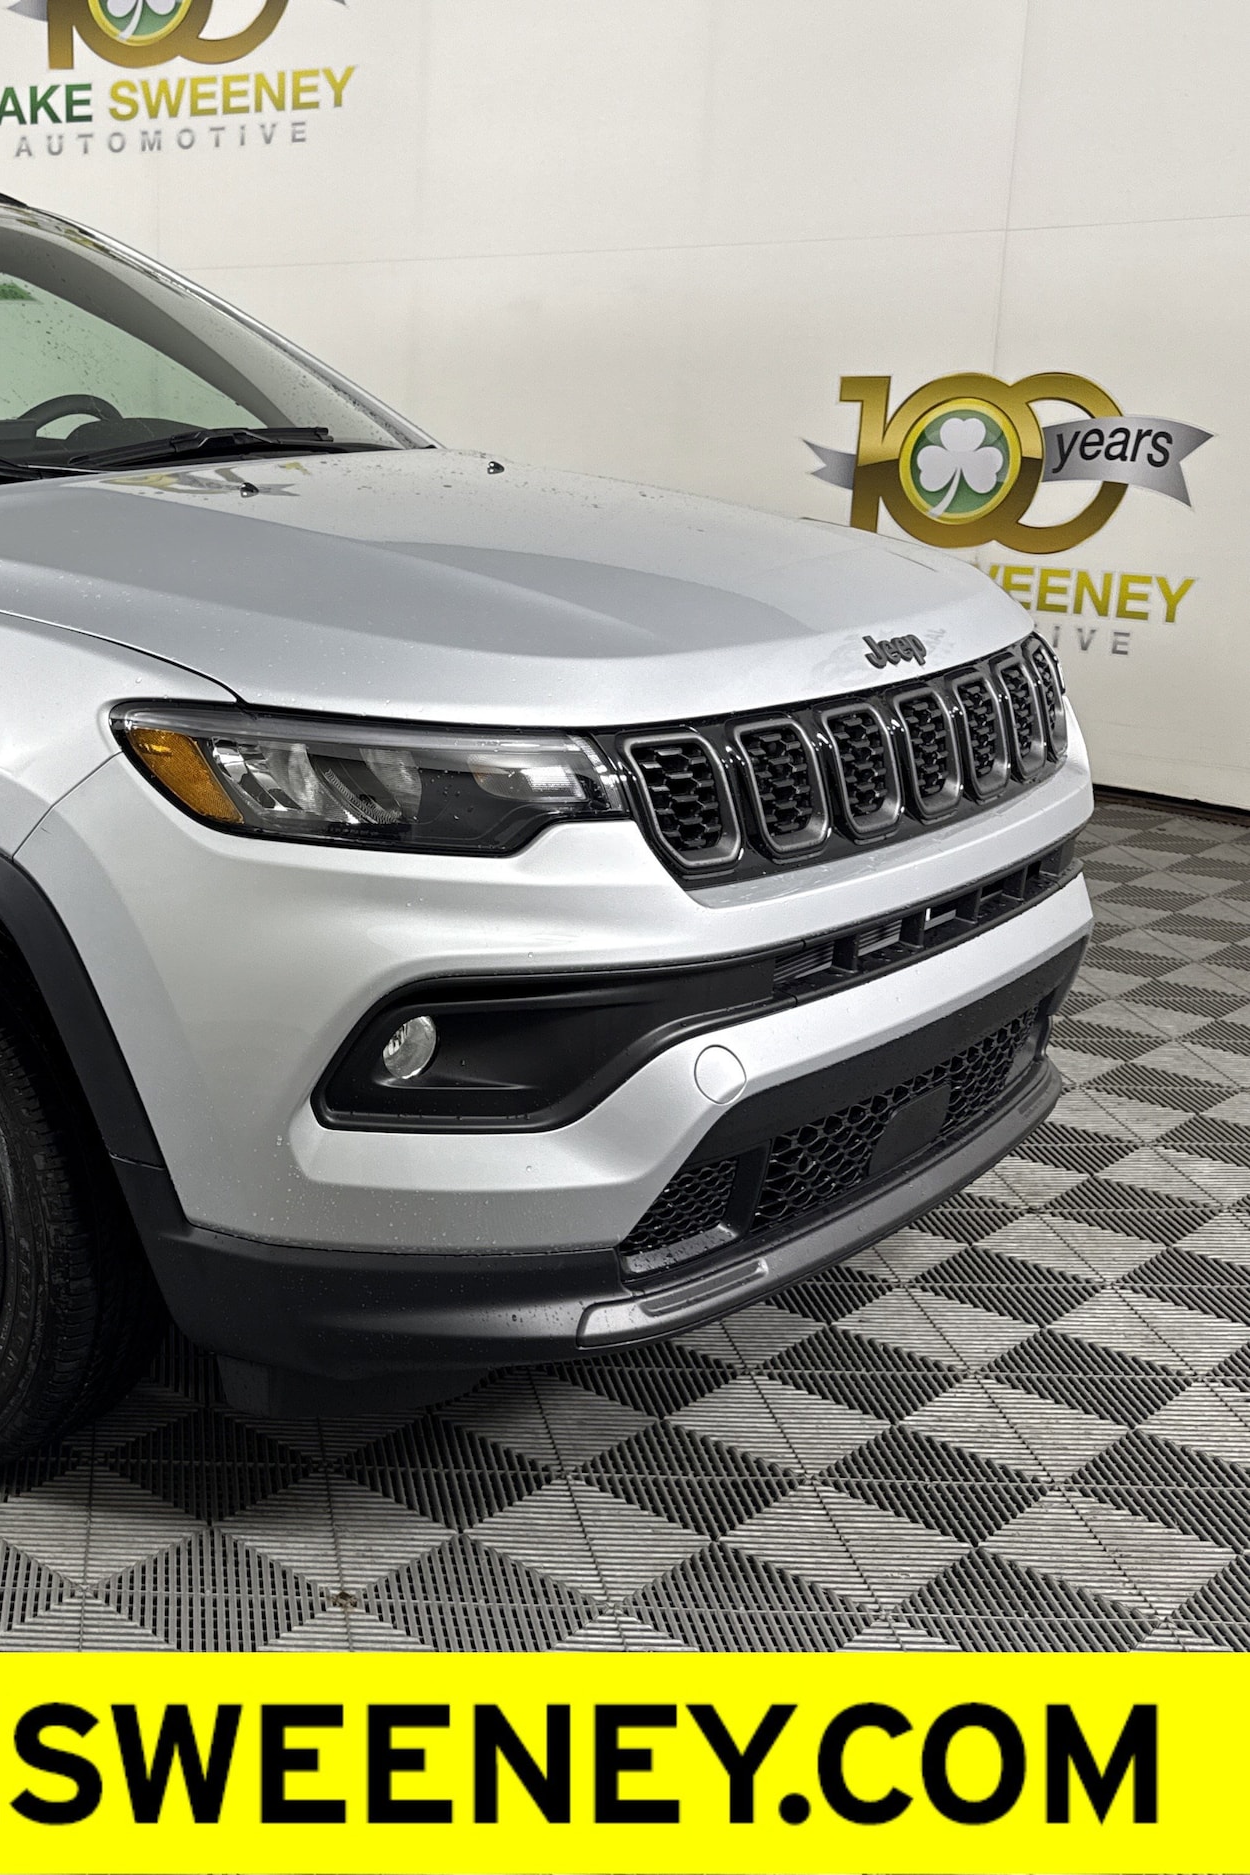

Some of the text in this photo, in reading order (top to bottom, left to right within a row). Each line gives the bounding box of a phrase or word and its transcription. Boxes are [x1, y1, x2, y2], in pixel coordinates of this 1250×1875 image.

[108, 66, 357, 121] SWEENEY
[15, 121, 307, 157] AUTOMOTIVE
[839, 372, 1174, 555] 100 years
[862, 634, 927, 669] Jeep
